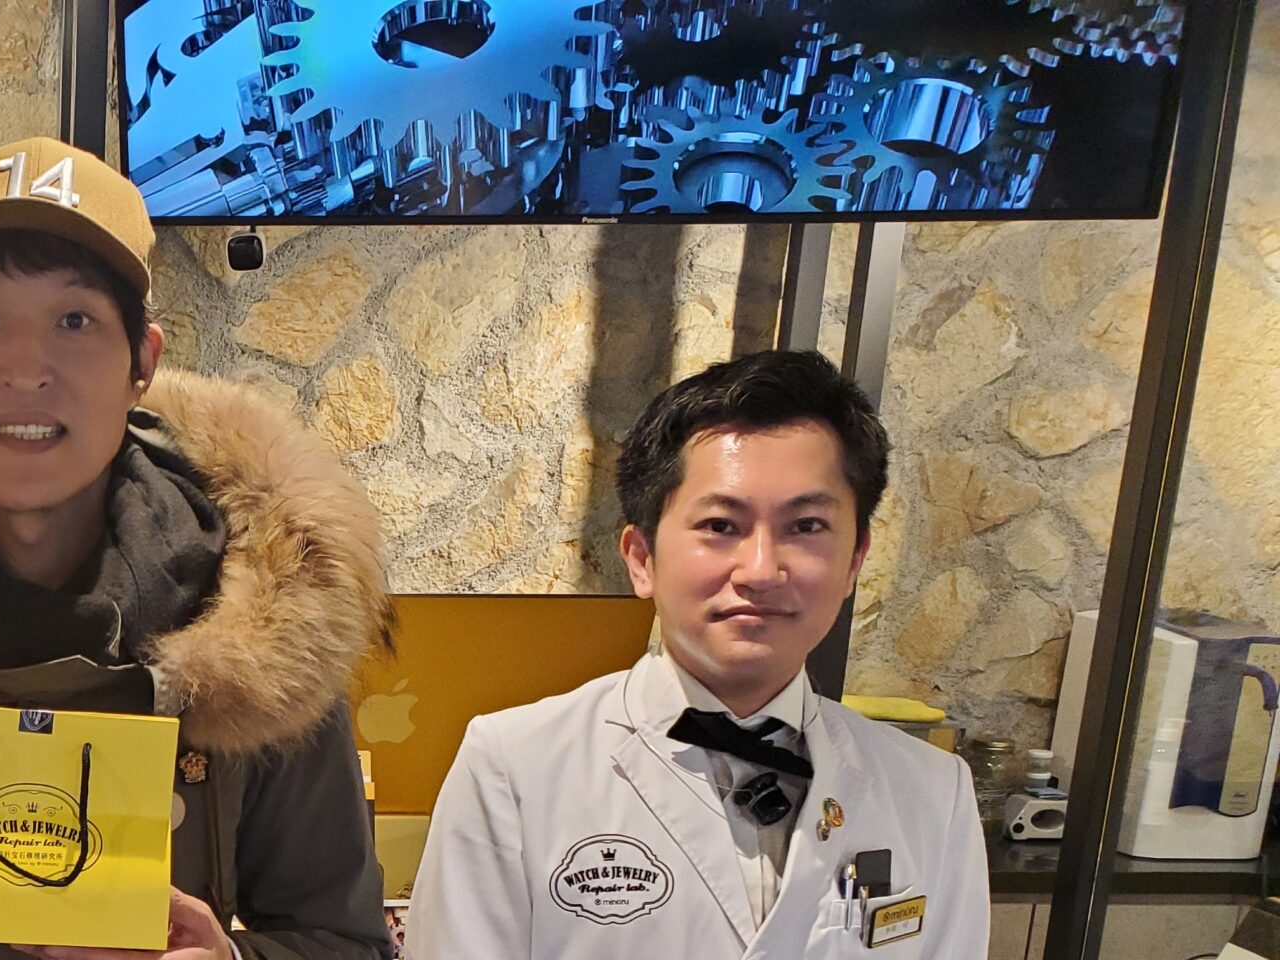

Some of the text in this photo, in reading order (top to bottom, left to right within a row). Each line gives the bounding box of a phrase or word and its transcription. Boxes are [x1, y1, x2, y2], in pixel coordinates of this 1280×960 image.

[20, 819, 30, 832] &
[43, 836, 66, 848] lab.
[0, 850, 63, 861] 計宝石修理研究所
[563, 866, 660, 888] WATCH & JEWELRY
[578, 883, 625, 896] Repair
